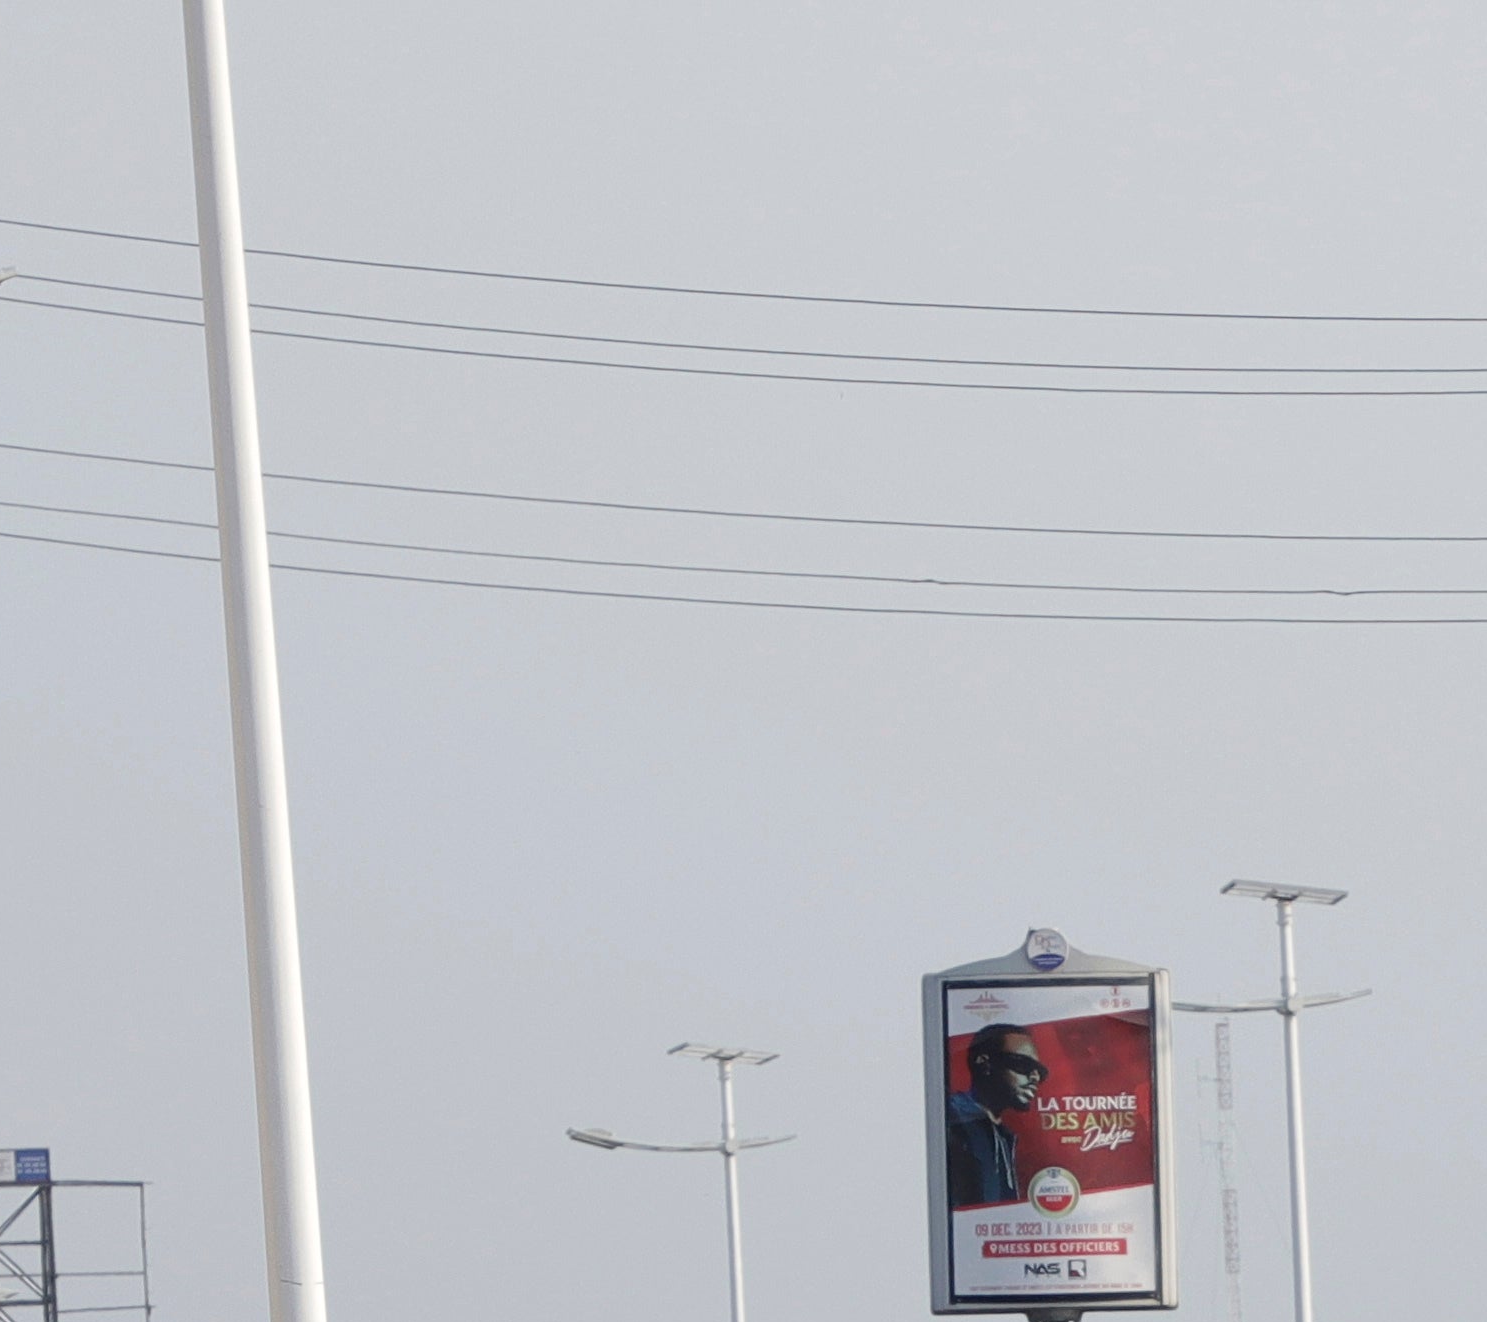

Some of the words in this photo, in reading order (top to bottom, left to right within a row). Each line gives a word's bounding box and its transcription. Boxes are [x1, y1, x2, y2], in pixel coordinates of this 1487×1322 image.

[1038, 1096, 1059, 1111] LA
[1062, 1091, 1137, 1110] TOURNÉE
[1041, 1112, 1080, 1130] DES
[1083, 1111, 1136, 1129] AMIS
[1016, 1222, 1042, 1236] 2023
[1065, 1223, 1099, 1234] PARTIR
[999, 1243, 1031, 1254] MESS
[1033, 1242, 1057, 1253] DES
[1059, 1241, 1120, 1253] OFFICIERS
